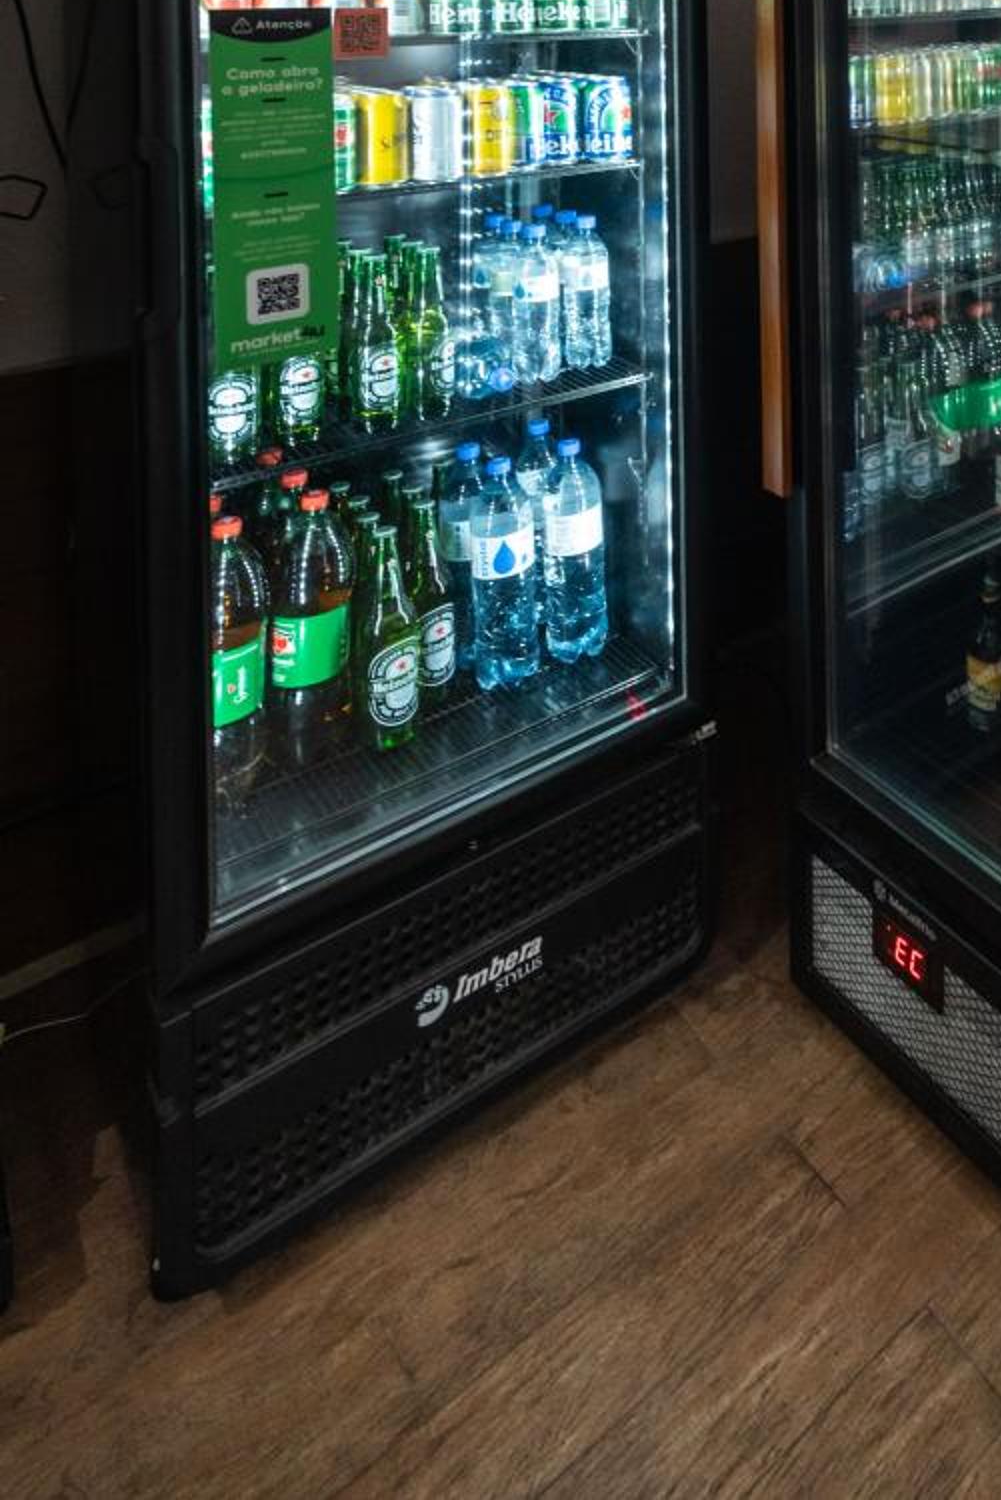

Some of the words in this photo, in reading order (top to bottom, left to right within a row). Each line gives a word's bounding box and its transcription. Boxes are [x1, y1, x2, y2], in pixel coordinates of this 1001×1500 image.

[226, 67, 275, 80] Como
[282, 64, 319, 77] abro
[221, 85, 232, 96] a
[238, 78, 324, 96] geladeira?
[453, 936, 543, 1003] Imbera
[494, 955, 543, 993] STYLUS
